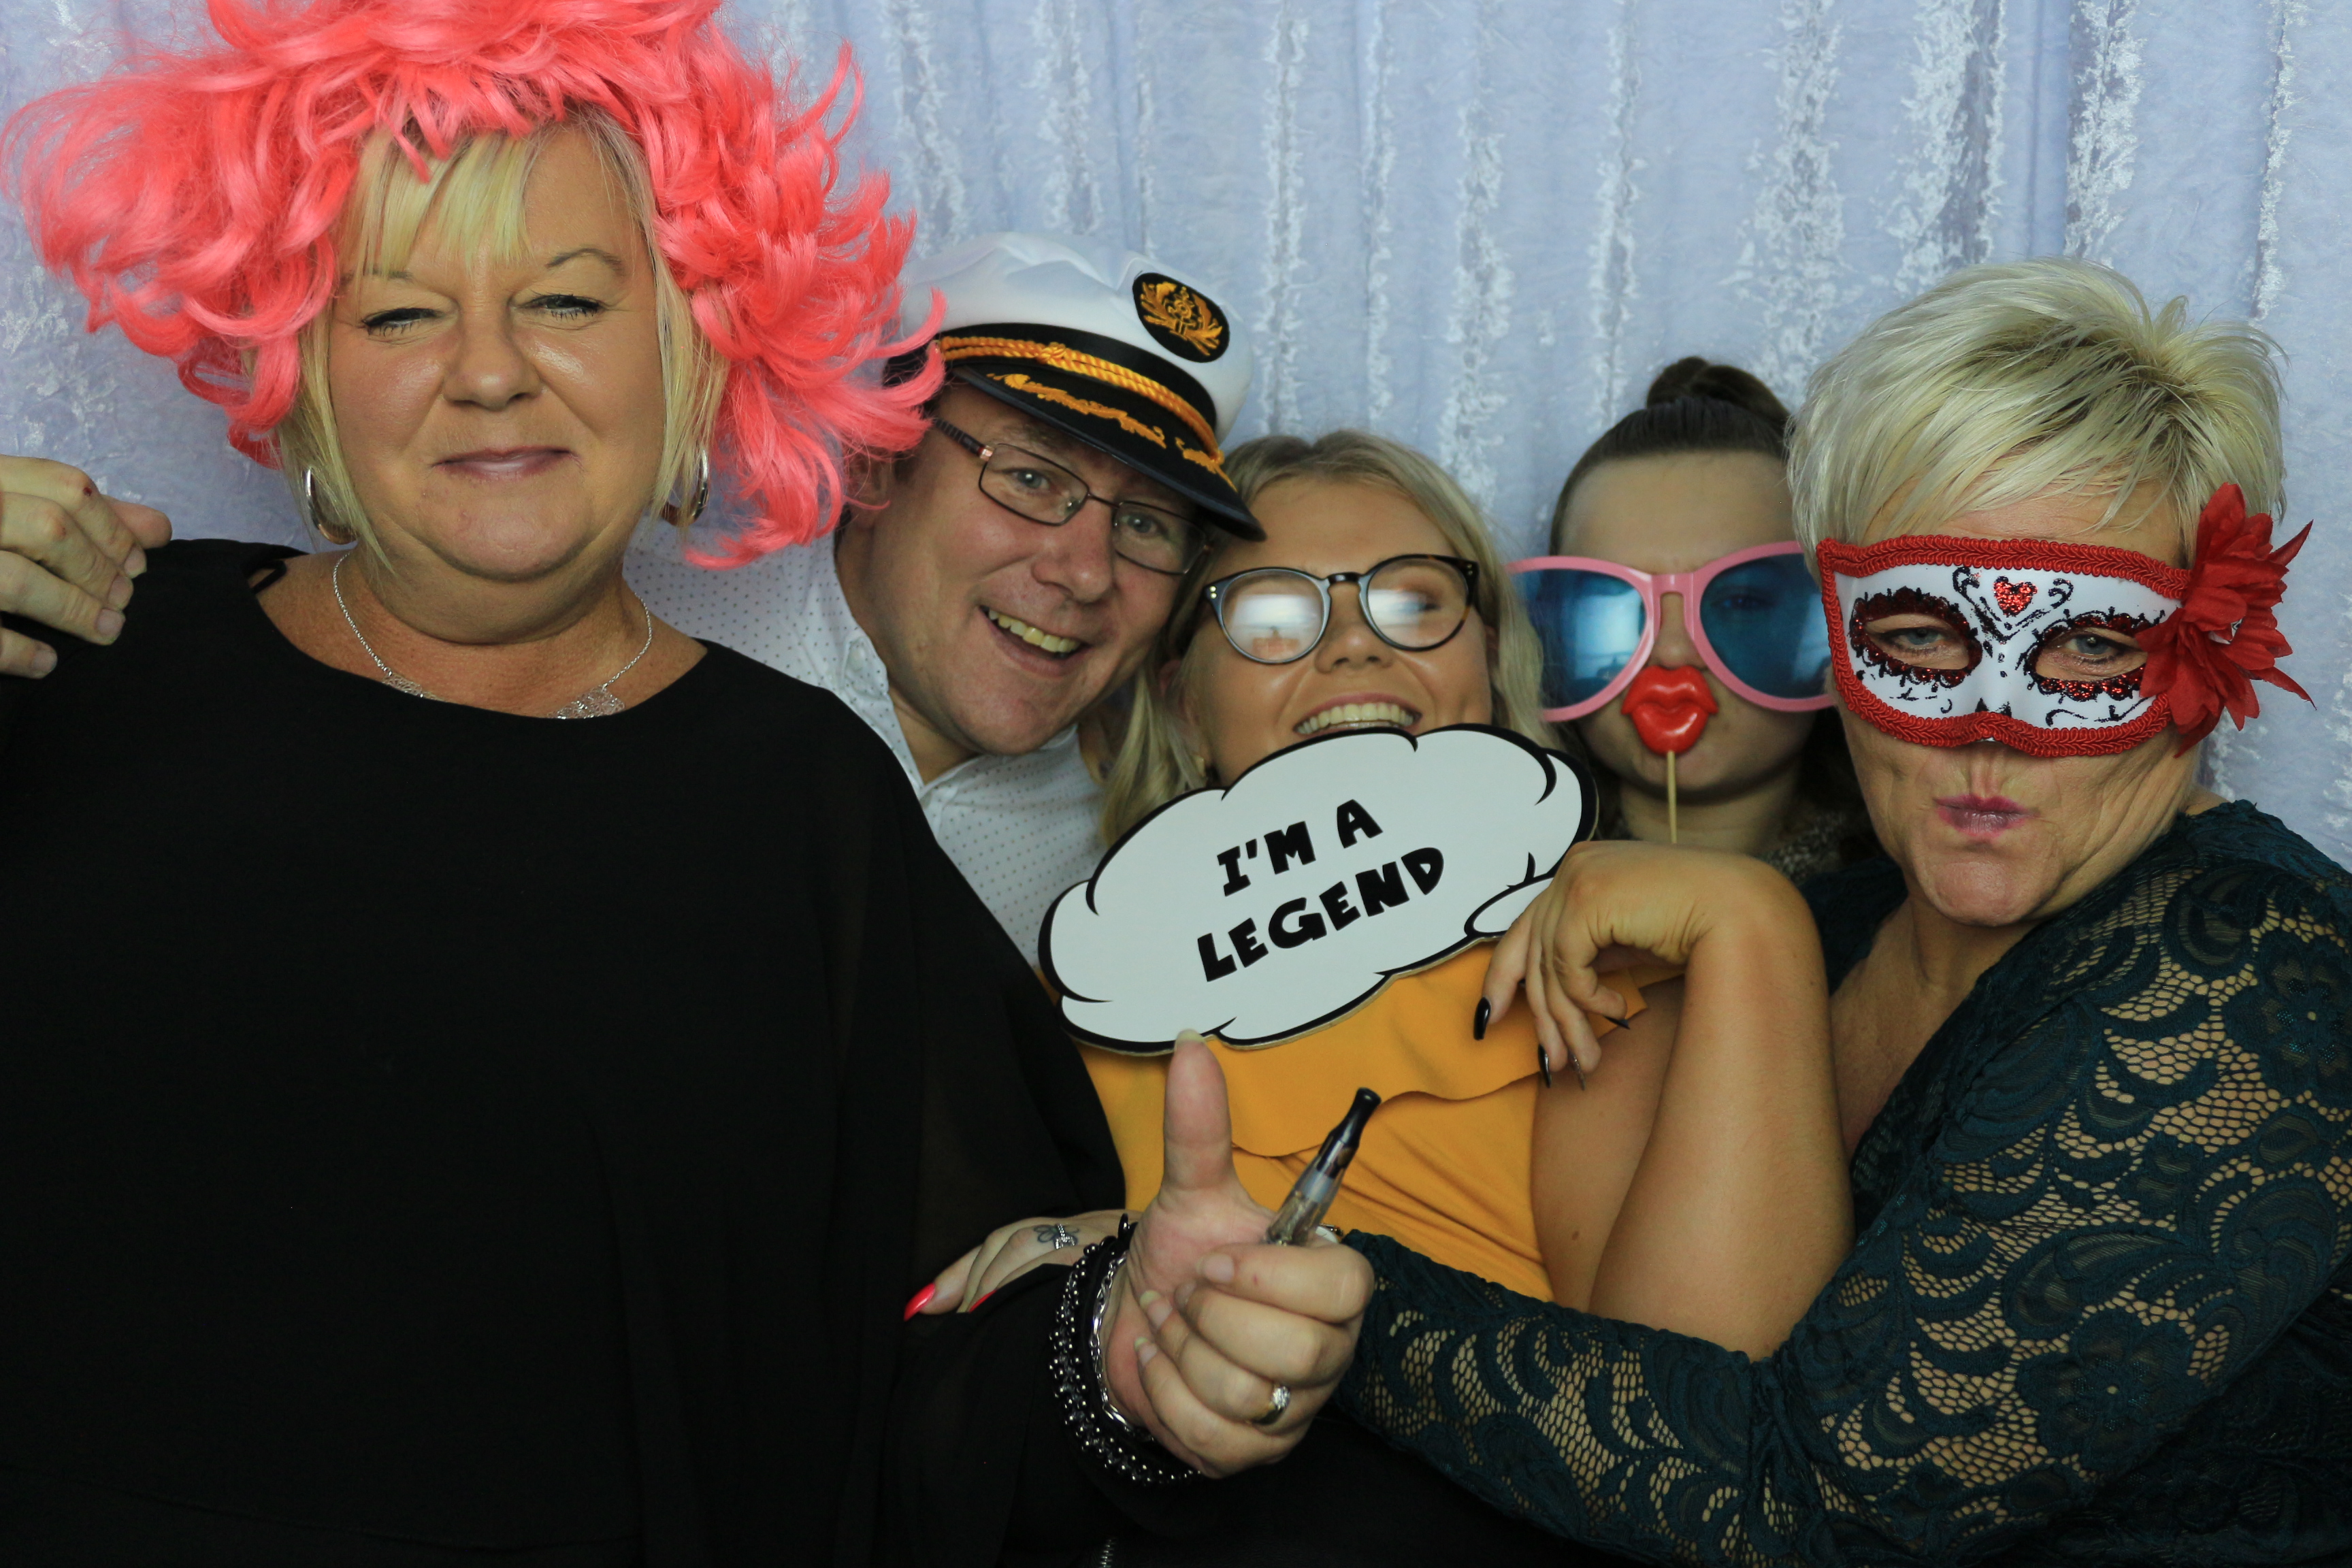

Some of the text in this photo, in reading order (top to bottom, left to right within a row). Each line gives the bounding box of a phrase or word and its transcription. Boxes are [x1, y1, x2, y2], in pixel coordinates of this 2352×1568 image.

[1216, 799, 1383, 897] I'M A
[1197, 847, 1444, 982] LEGEND
